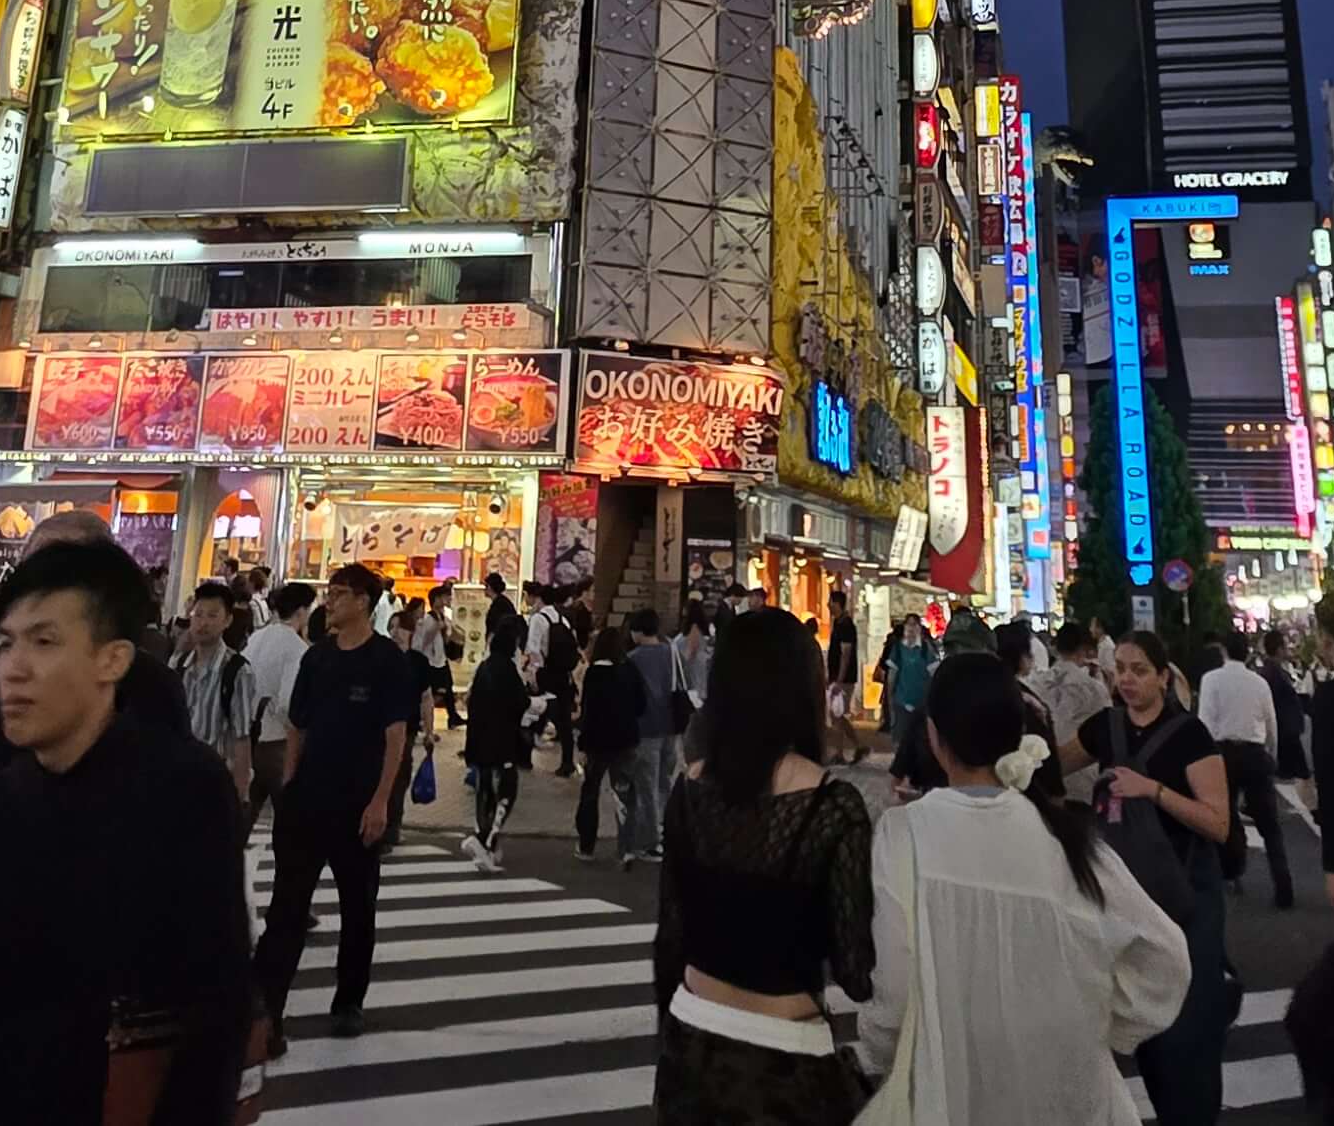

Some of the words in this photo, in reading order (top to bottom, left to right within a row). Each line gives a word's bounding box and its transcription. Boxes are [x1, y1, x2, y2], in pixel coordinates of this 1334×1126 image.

[273, 5, 302, 41] 光
[261, 93, 294, 120] 4F
[1173, 173, 1222, 189] HOTEL
[1221, 170, 1290, 187] GRACERY
[409, 241, 474, 254] MONJA
[1189, 264, 1231, 275] IMAX
[1113, 250, 1140, 420] GODZILLA
[295, 367, 334, 385] 200
[474, 358, 540, 376] らーめん
[294, 389, 372, 406] ミニカレー
[585, 370, 784, 417] OKONOMIYAKI
[288, 426, 328, 445] 200
[593, 407, 765, 453] お好み焼き
[1125, 441, 1145, 528] ROAD
